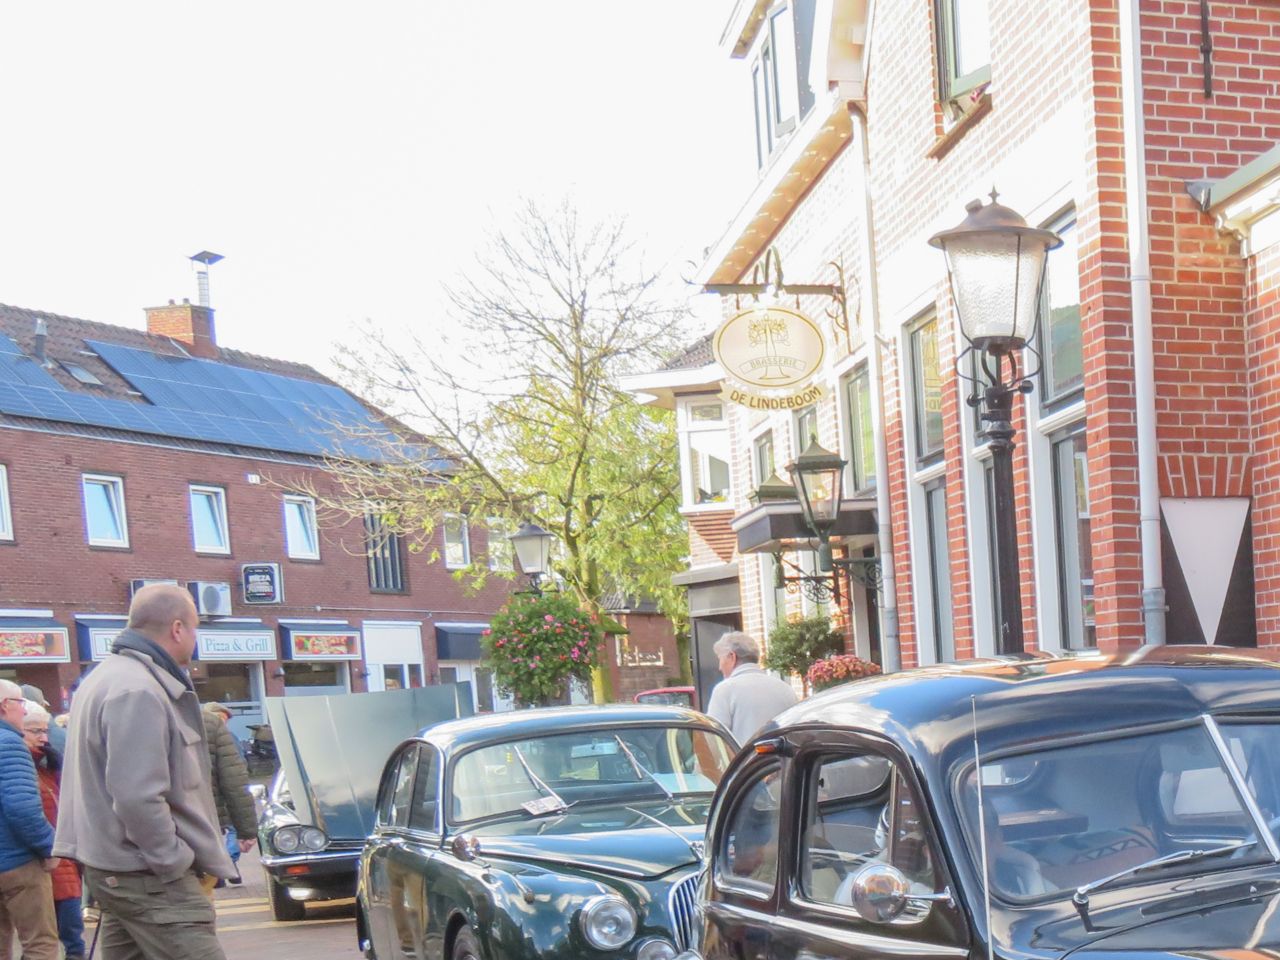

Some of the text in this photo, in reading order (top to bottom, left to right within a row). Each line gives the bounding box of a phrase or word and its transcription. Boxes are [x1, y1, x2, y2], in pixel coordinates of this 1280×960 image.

[749, 356, 798, 369] BRASSERIE
[730, 386, 823, 409] DE LINDEBOOM
[205, 637, 268, 651] Pizza & Grill
